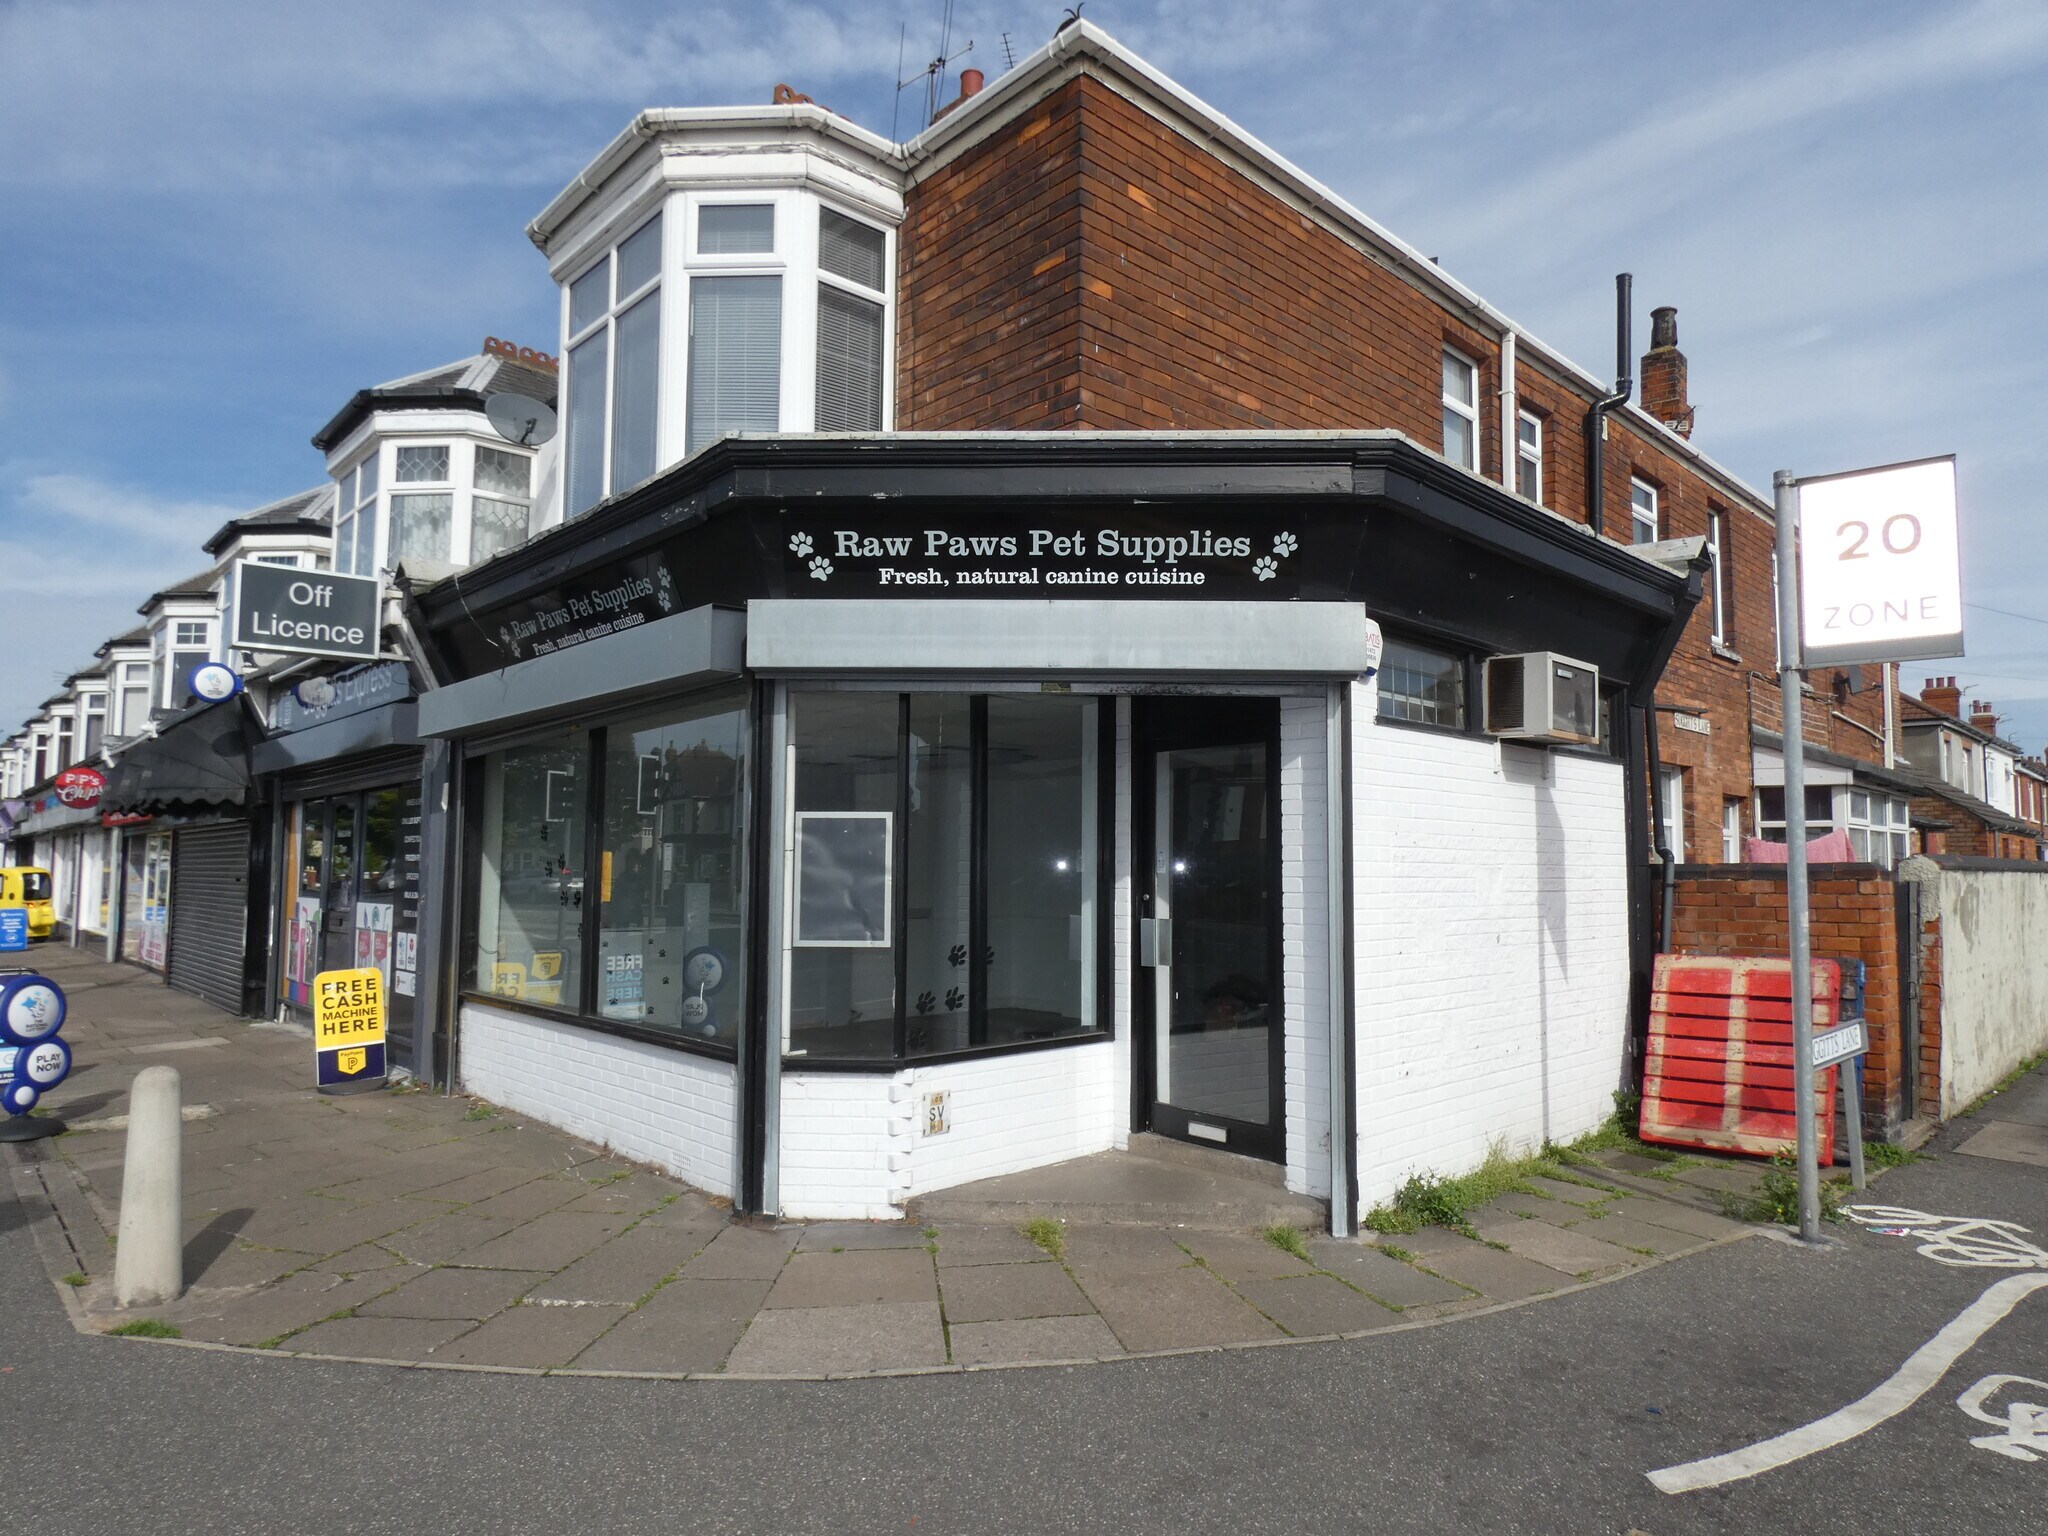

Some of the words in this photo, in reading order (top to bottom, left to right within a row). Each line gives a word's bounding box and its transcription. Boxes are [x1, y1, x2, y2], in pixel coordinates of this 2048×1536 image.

[834, 529, 913, 558] Raw
[923, 529, 1018, 558] Paws
[1028, 529, 1087, 558] Pet
[1096, 528, 1252, 565] Supplies
[1835, 512, 1922, 562] 20
[878, 567, 951, 589] Fresh,
[956, 566, 1040, 585] natural
[1045, 567, 1120, 585] canine
[1125, 567, 1206, 585] cuisine
[288, 581, 334, 608] Off
[510, 618, 539, 641] Raw
[535, 607, 572, 631] Paws
[569, 593, 592, 620] Pet
[590, 575, 655, 614] Supplies
[1823, 594, 1940, 632] ZONE
[252, 611, 364, 646] Licence
[532, 638, 559, 657] Fresh,
[557, 627, 587, 651] natural
[584, 618, 614, 641] canine
[612, 610, 646, 635] cuisine
[64, 772, 101, 786] PP's
[321, 977, 377, 996] FREE
[322, 992, 377, 1010] CASH
[322, 1006, 378, 1022] MACHINE
[323, 1017, 379, 1036] HERE
[1813, 1033, 1839, 1061] GGITTS
[1840, 1026, 1859, 1051] LANE
[36, 1053, 61, 1065] PLAY
[36, 1061, 62, 1073] NOW
[929, 1105, 945, 1122] SV
